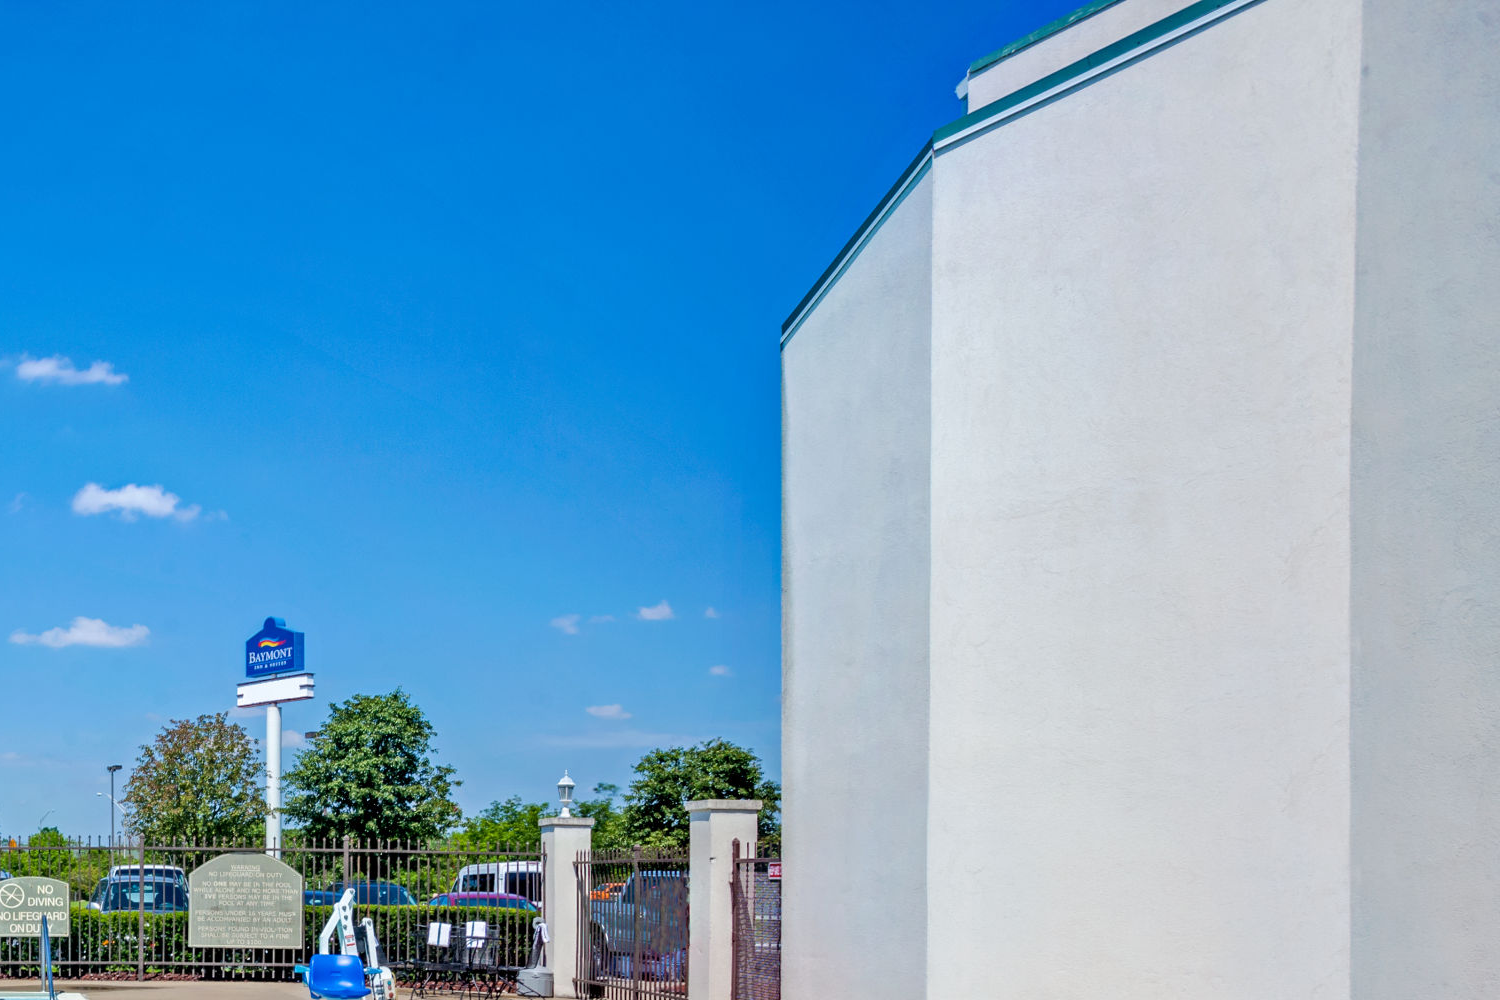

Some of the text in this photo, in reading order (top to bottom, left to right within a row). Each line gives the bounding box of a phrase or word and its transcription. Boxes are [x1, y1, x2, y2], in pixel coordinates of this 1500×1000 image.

[249, 647, 292, 664] BAYMONT
[37, 885, 54, 895] NO
[27, 897, 64, 907] DIVING
[9, 923, 53, 933] ON DUY
